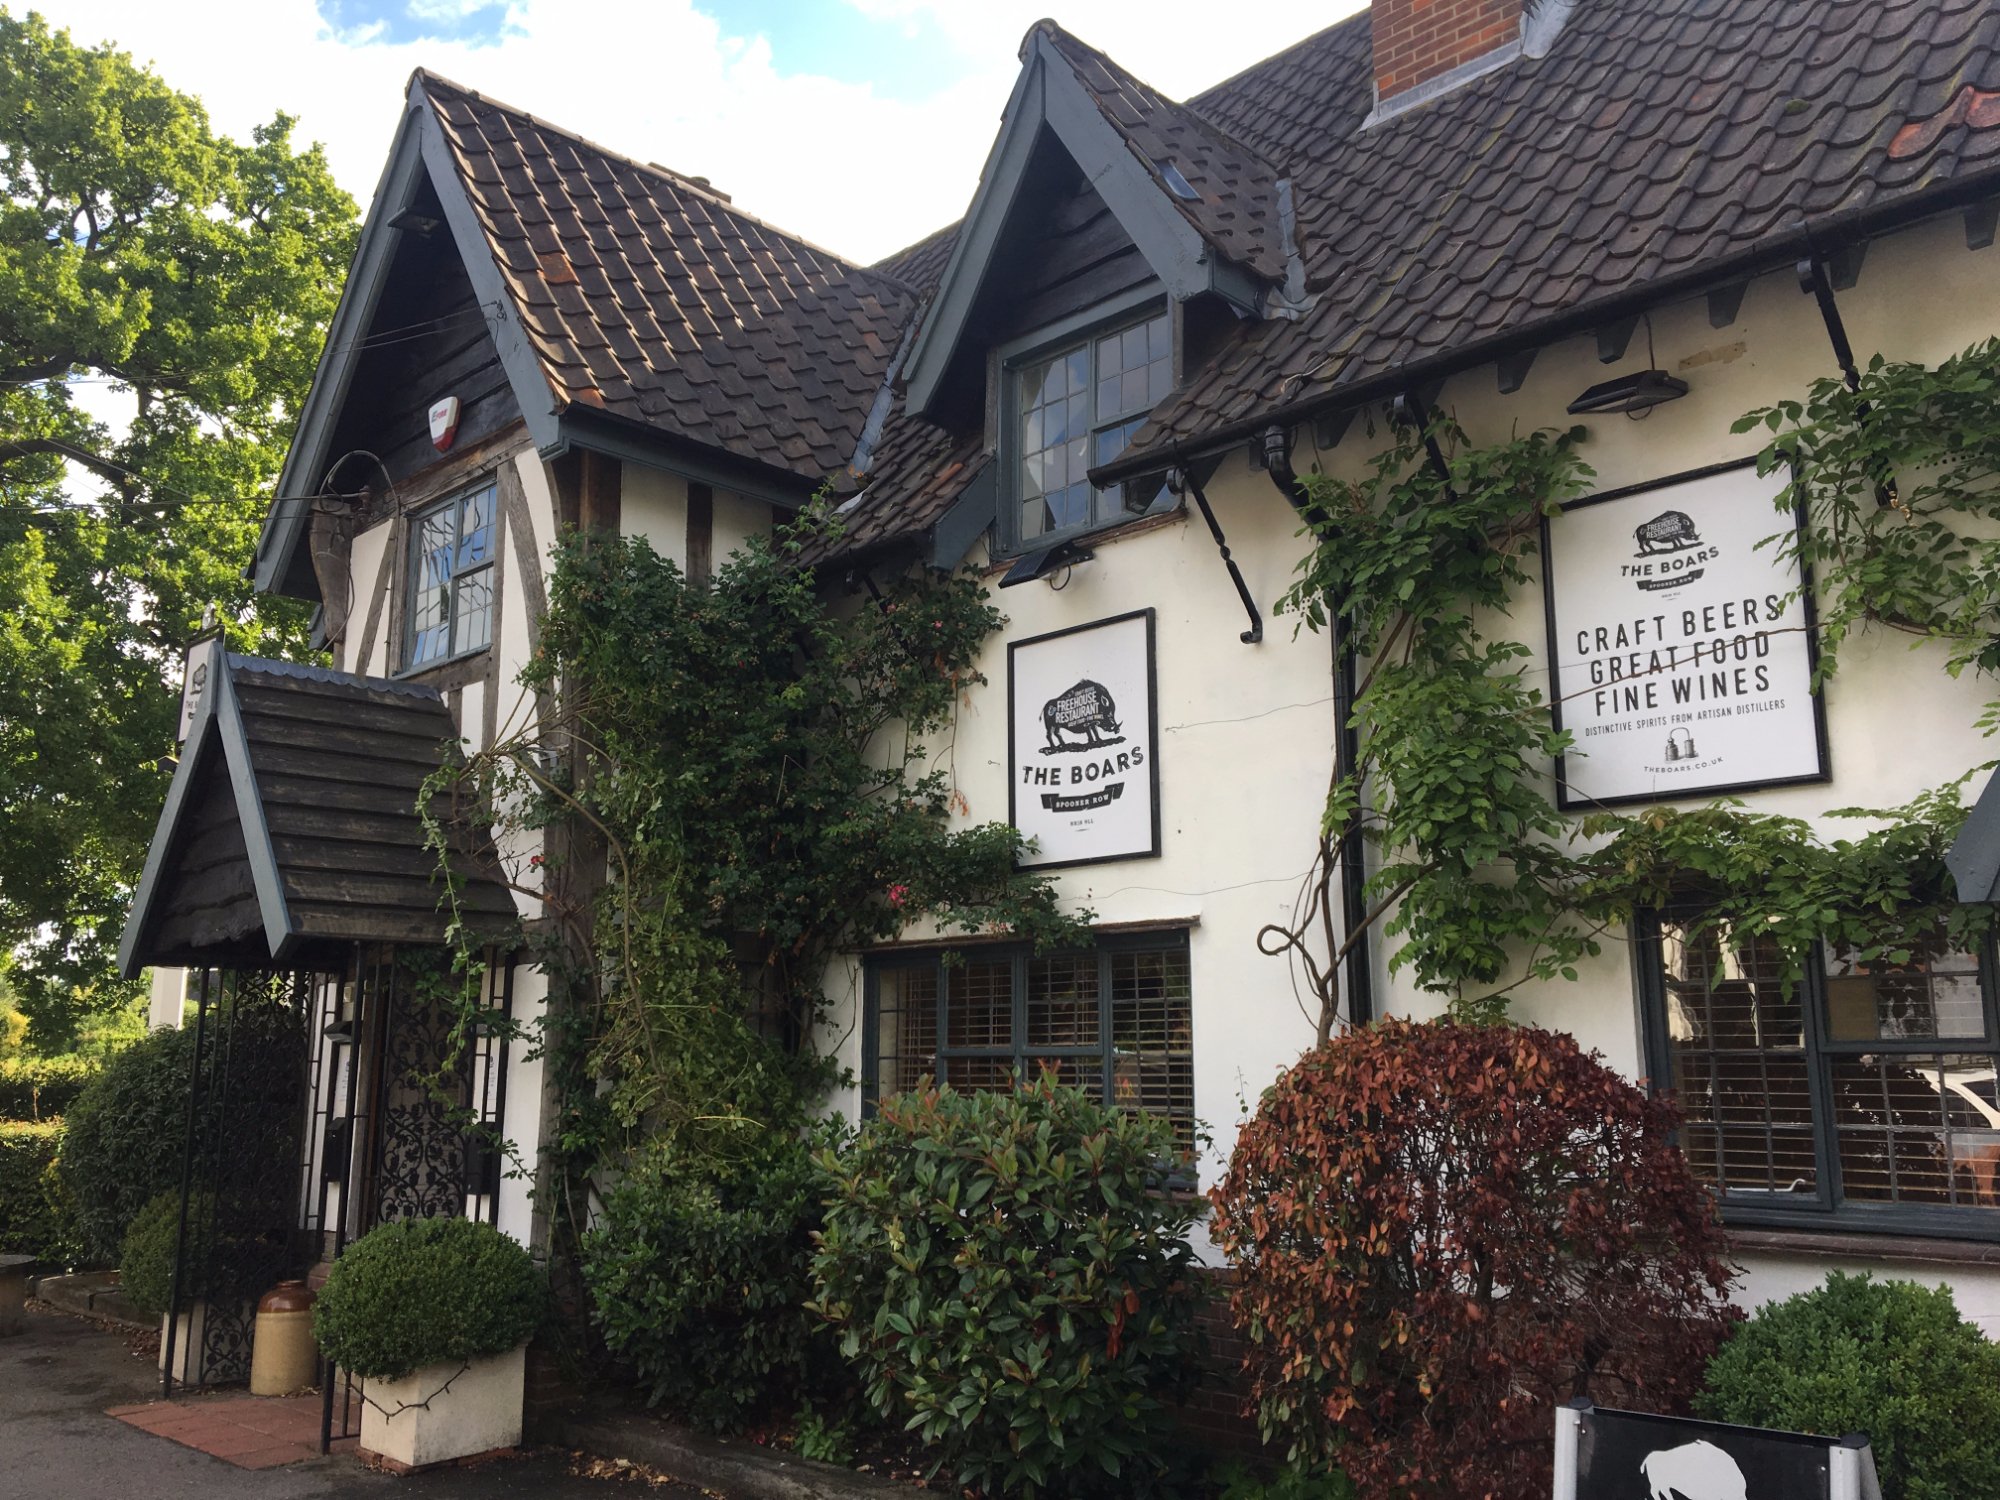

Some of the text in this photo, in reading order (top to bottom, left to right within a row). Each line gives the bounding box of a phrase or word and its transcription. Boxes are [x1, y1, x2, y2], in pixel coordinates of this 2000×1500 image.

[1646, 524, 1682, 538] RESTAURANT
[1647, 517, 1680, 531] FREEHOUSE
[1621, 546, 1719, 576] THE BOARS
[1577, 594, 1780, 655] CRAFT BEERS
[1590, 631, 1769, 685] GREAT FOOD
[1057, 691, 1097, 711] FREEHOUSE
[1595, 665, 1769, 716] FINE WINES
[1055, 702, 1099, 723] RESTAURANT
[1585, 699, 1786, 737] DISTINCTIVE SPIRITS FROM ARTISAN DISTILLERS
[1022, 746, 1144, 786] THE BOARS
[1644, 756, 1723, 774] THEBOARS.CO.UK
[1055, 794, 1109, 808] SPOONER ROW
